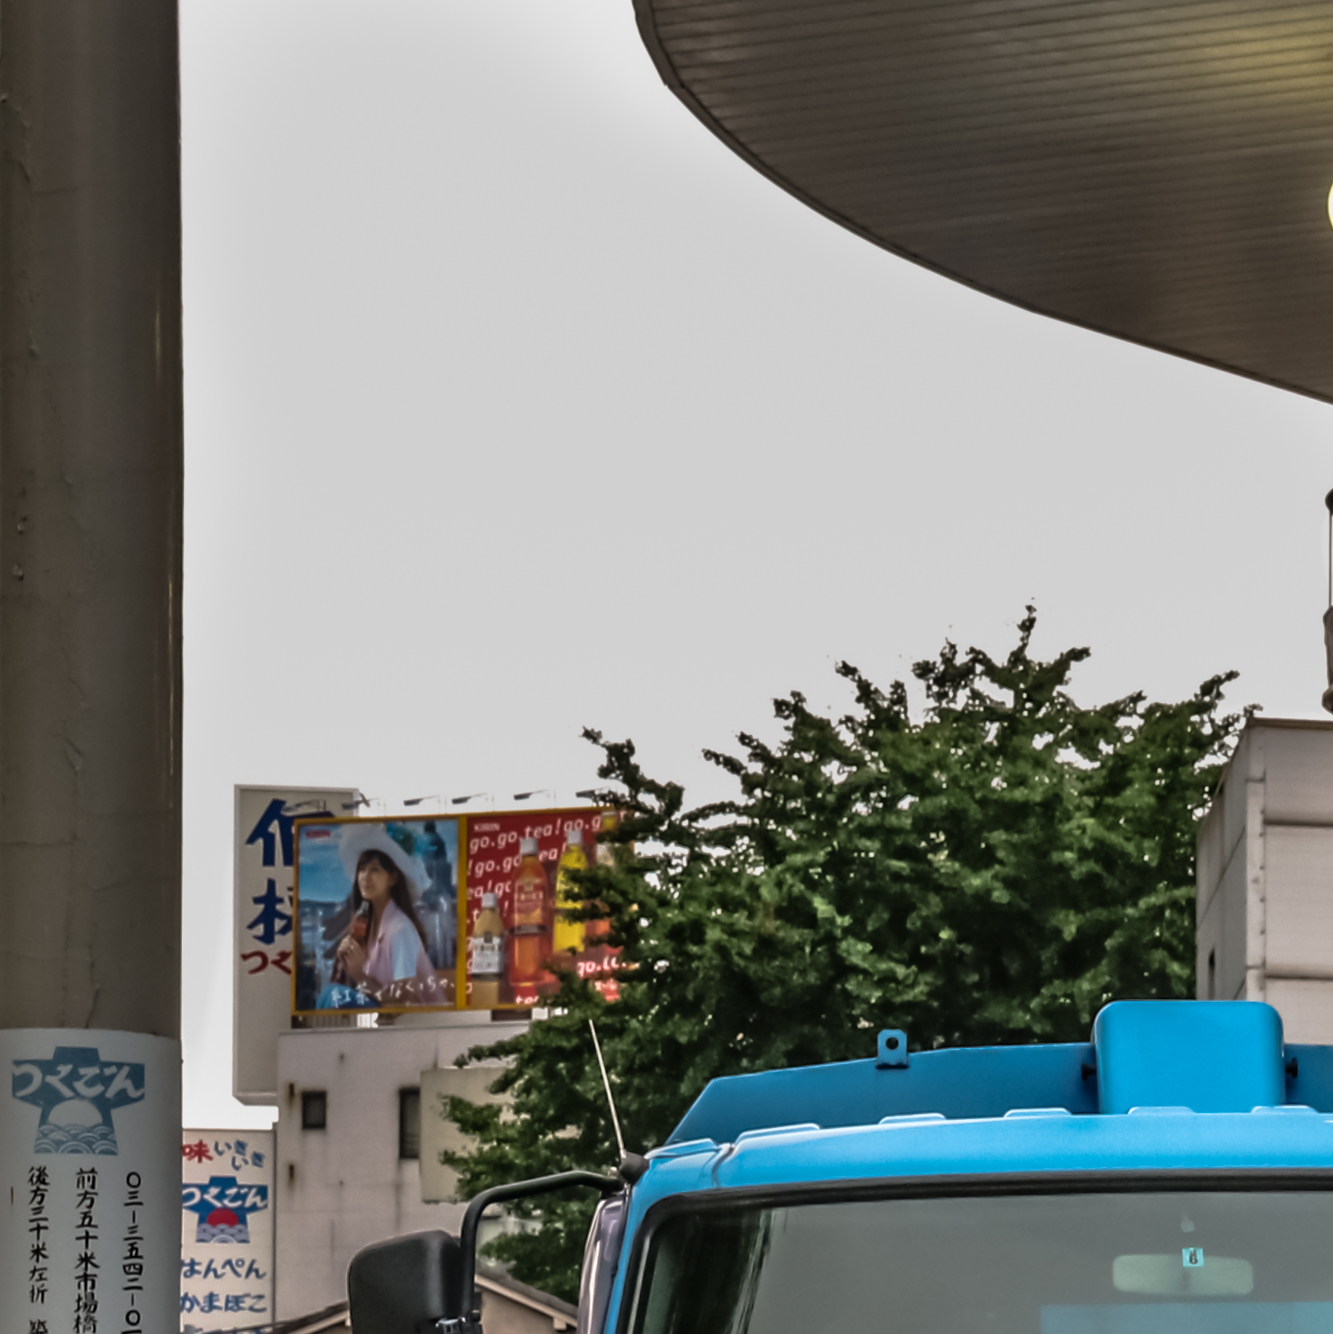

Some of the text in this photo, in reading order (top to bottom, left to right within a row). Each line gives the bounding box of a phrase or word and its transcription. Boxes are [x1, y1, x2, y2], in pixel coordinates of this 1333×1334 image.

[12, 1062, 145, 1099] つくごん
[182, 1185, 266, 1208] つくごん
[28, 1165, 50, 1304] 後方三十米左折
[180, 1291, 267, 1313] かまぼこ
